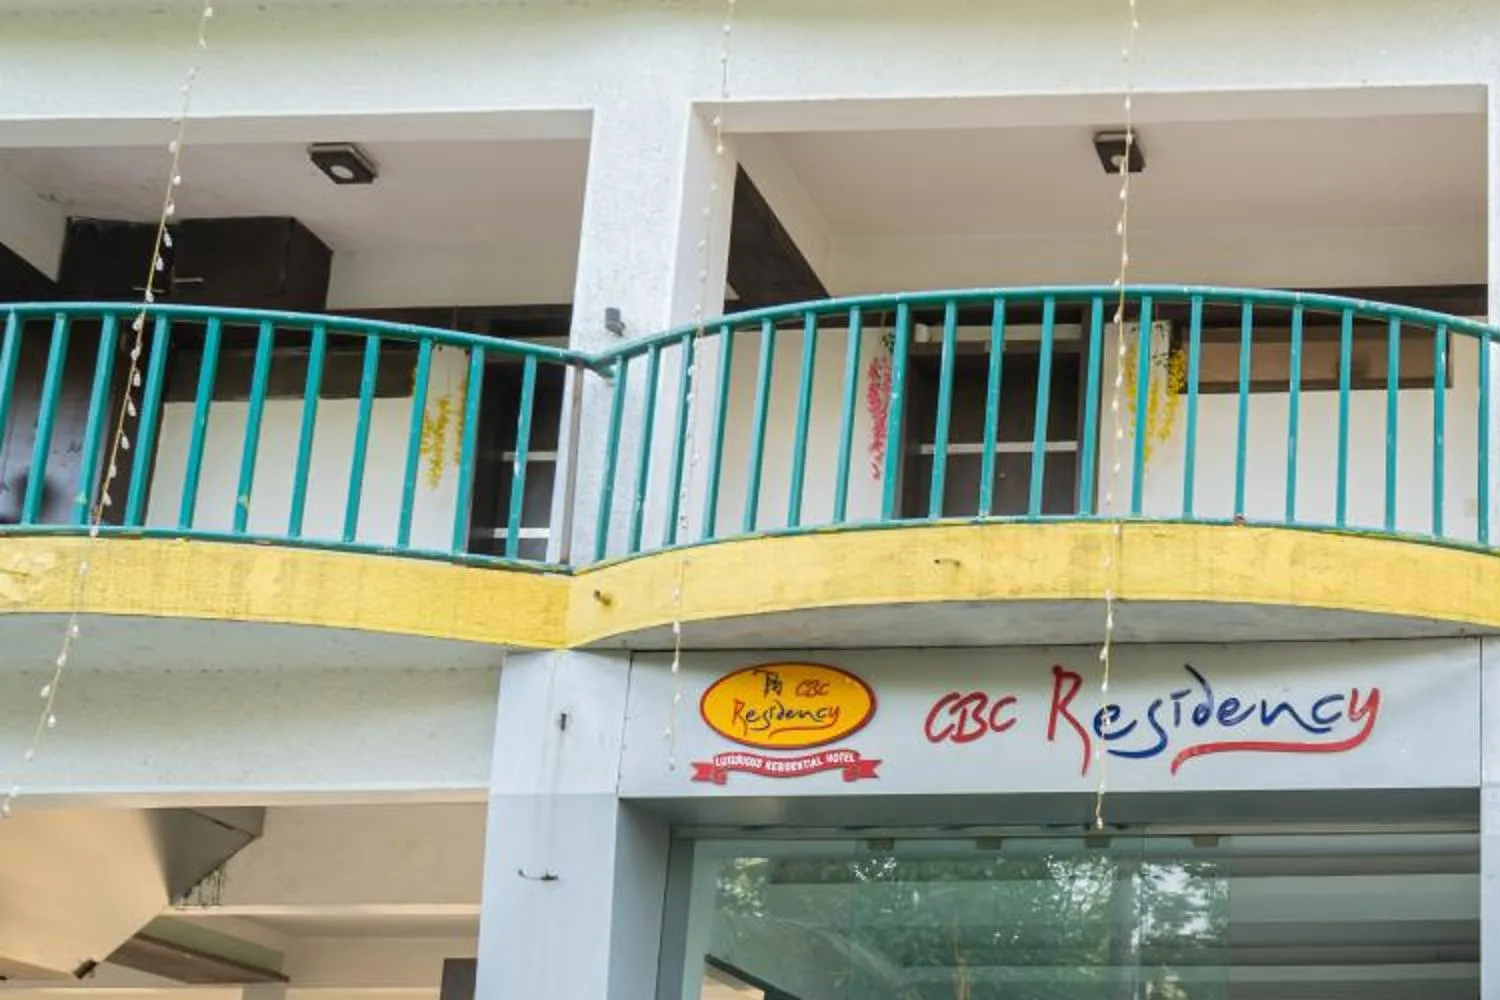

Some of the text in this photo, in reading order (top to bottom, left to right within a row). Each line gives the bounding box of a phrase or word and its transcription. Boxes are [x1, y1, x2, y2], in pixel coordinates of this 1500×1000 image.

[795, 679, 829, 697] CBC
[732, 699, 840, 740] Residency
[924, 664, 1381, 777] CBC Residency
[826, 752, 855, 763] HOTEL
